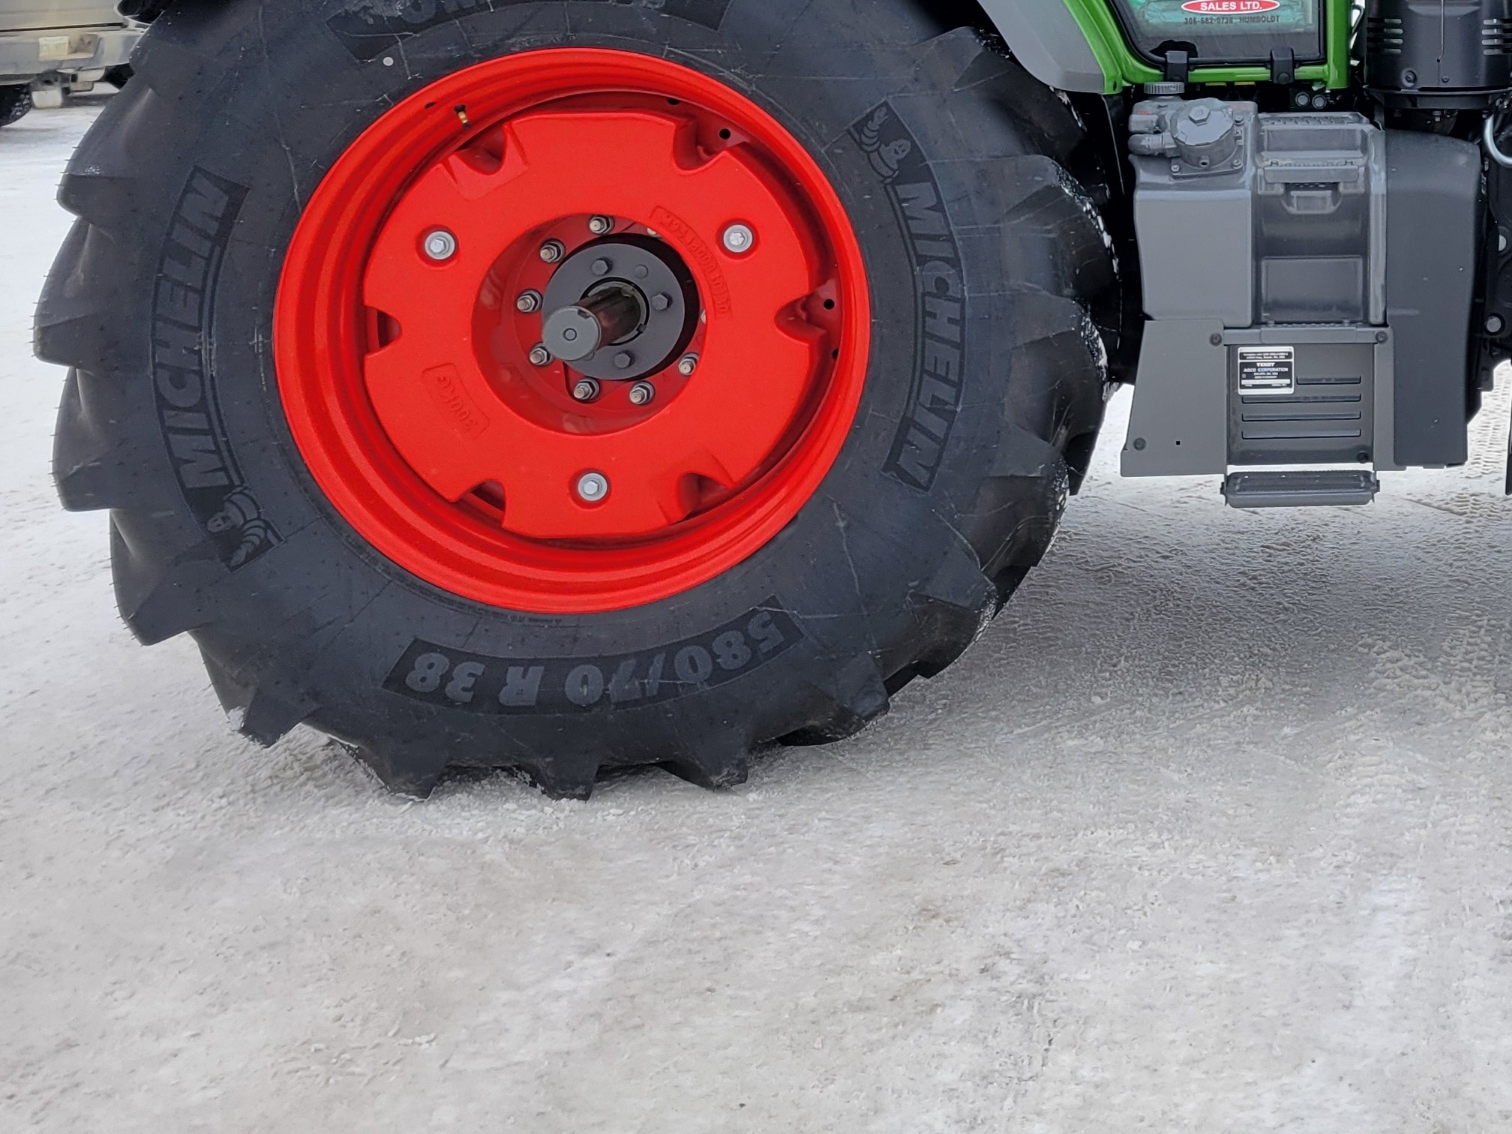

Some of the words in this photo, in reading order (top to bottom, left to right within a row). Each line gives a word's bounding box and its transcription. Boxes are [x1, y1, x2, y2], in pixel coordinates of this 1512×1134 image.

[1200, 2, 1237, 11] SALES
[1239, 1, 1262, 10] LTD.
[1239, 15, 1280, 24] HUMBOLDT
[154, 170, 231, 489] MICHELIN
[895, 181, 963, 485] MICHELIN
[404, 652, 487, 704] 38
[563, 611, 785, 705] 580/70
[499, 665, 544, 707] R
